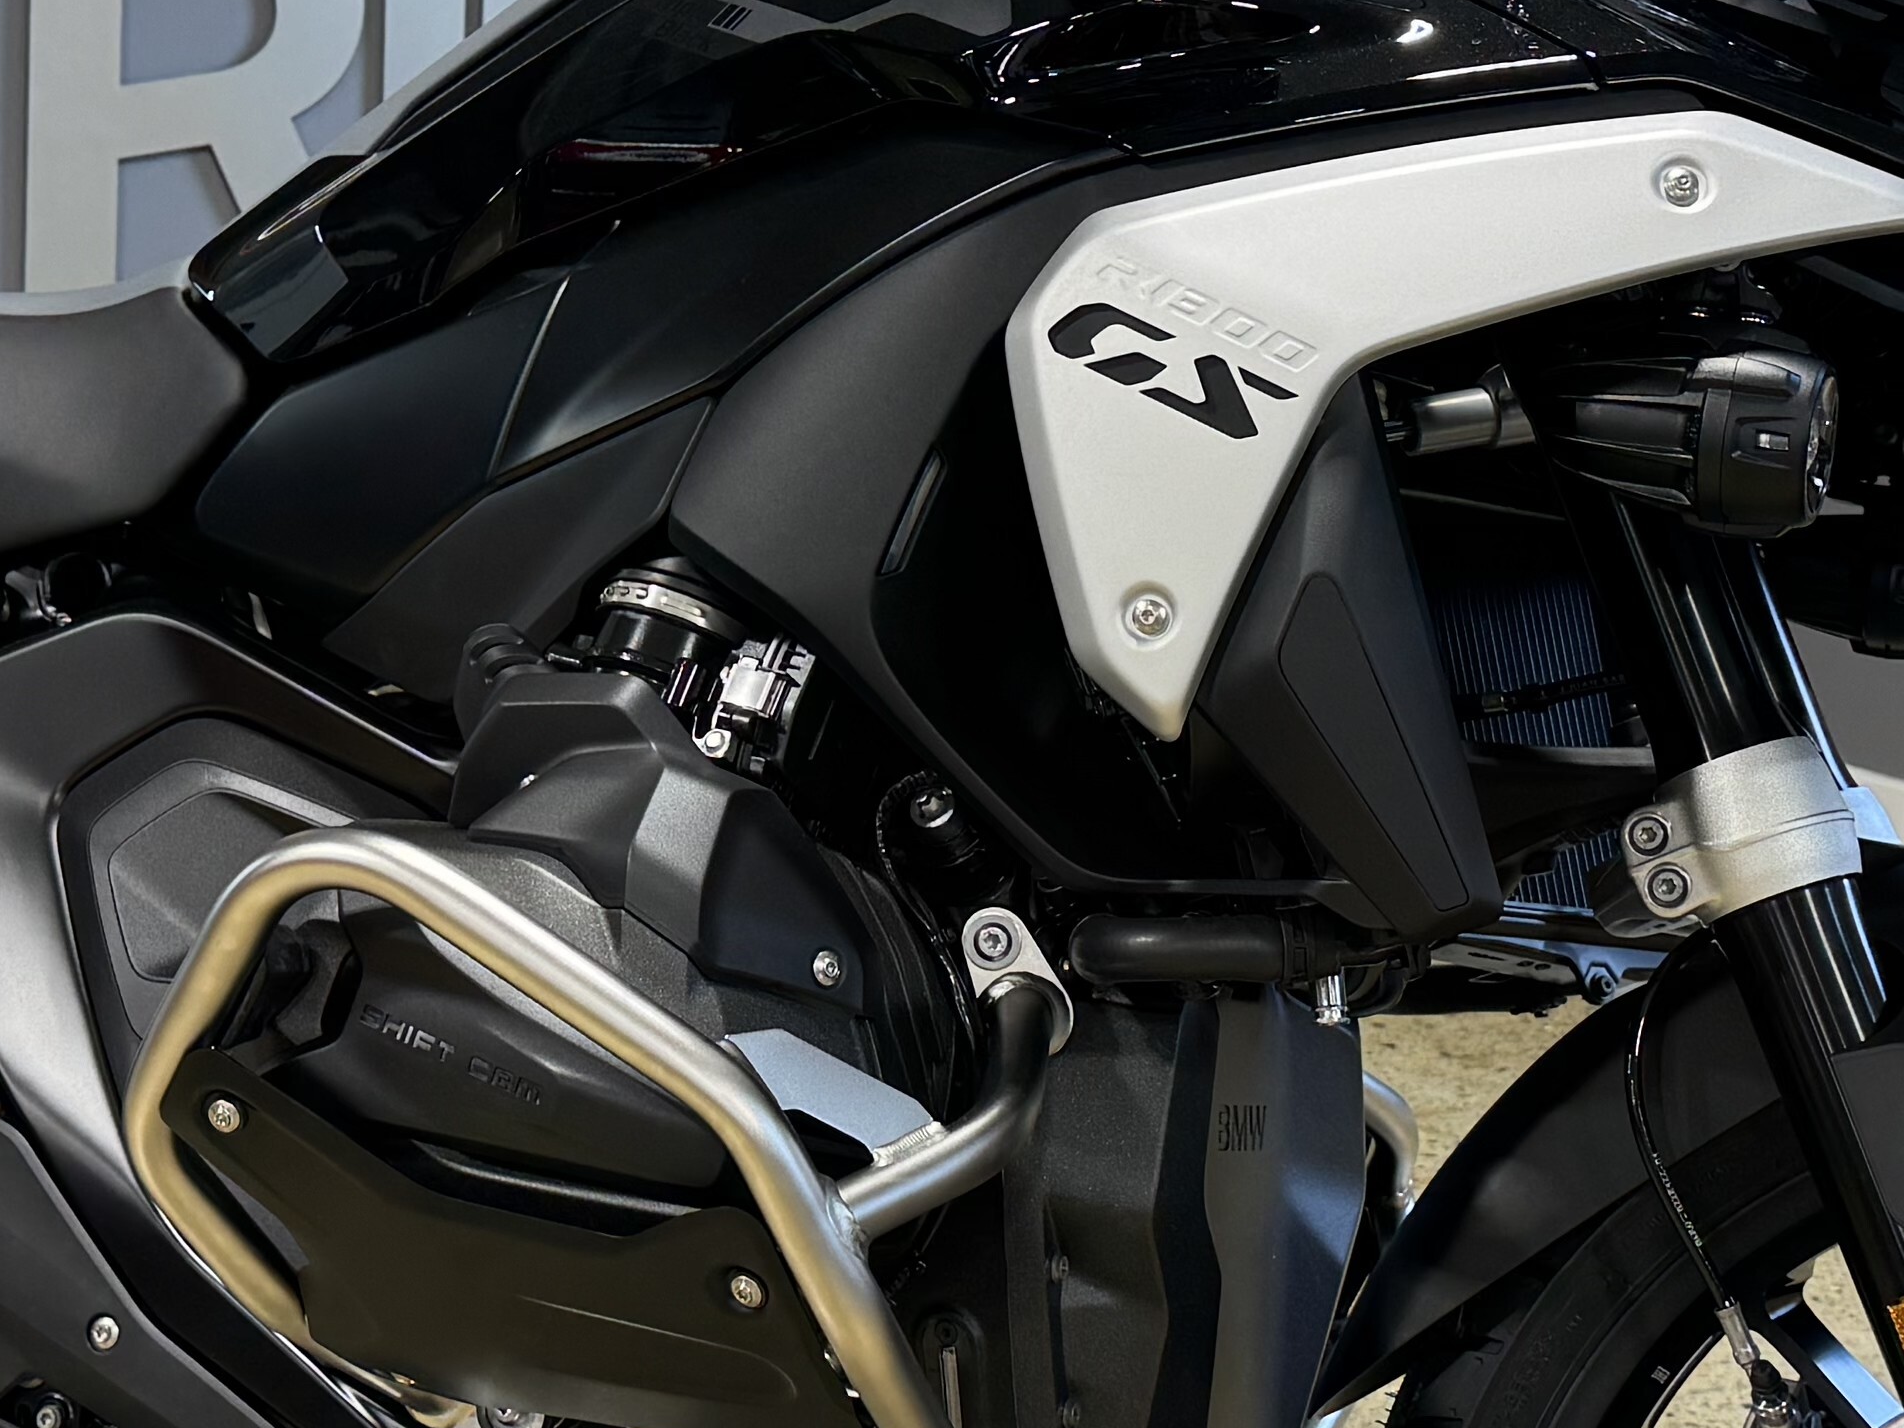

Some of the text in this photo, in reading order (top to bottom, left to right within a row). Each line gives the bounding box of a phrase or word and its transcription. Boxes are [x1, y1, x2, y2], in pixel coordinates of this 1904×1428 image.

[1047, 302, 1300, 440] GS
[359, 1003, 457, 1064] SHIFT
[1217, 1103, 1267, 1152] BMW
